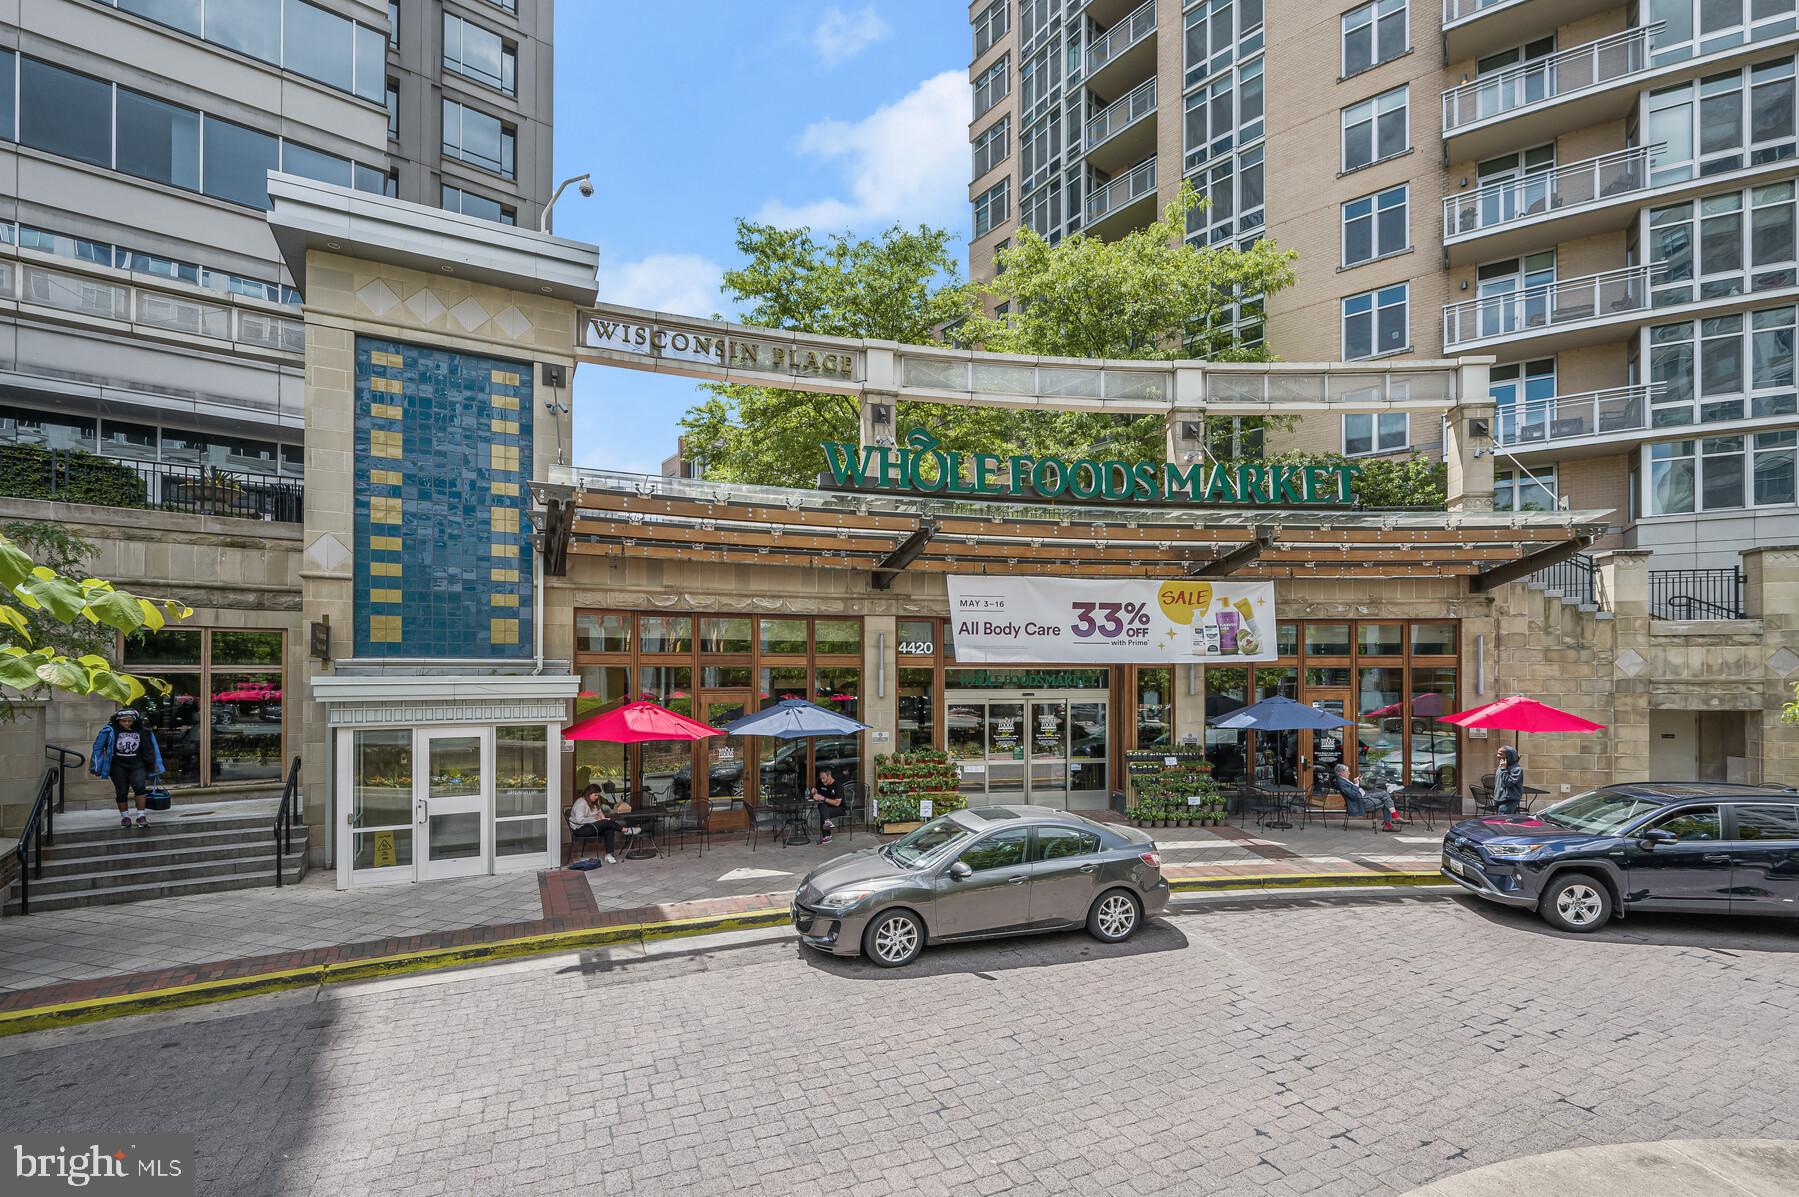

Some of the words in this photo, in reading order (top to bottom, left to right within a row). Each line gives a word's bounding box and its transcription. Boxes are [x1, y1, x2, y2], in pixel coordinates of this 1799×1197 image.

[590, 319, 759, 363] WISCONSIN
[772, 348, 853, 375] PLACE
[820, 428, 1001, 493] WHOLE
[1006, 455, 1157, 500] FOODS
[1163, 462, 1362, 504] MARKET
[1161, 589, 1209, 606] SALE
[1071, 602, 1151, 638] 33%
[959, 621, 978, 635] All
[984, 622, 1021, 638] Body
[1025, 622, 1061, 636] Care
[1126, 628, 1149, 637] OFF
[898, 641, 933, 654] 4420
